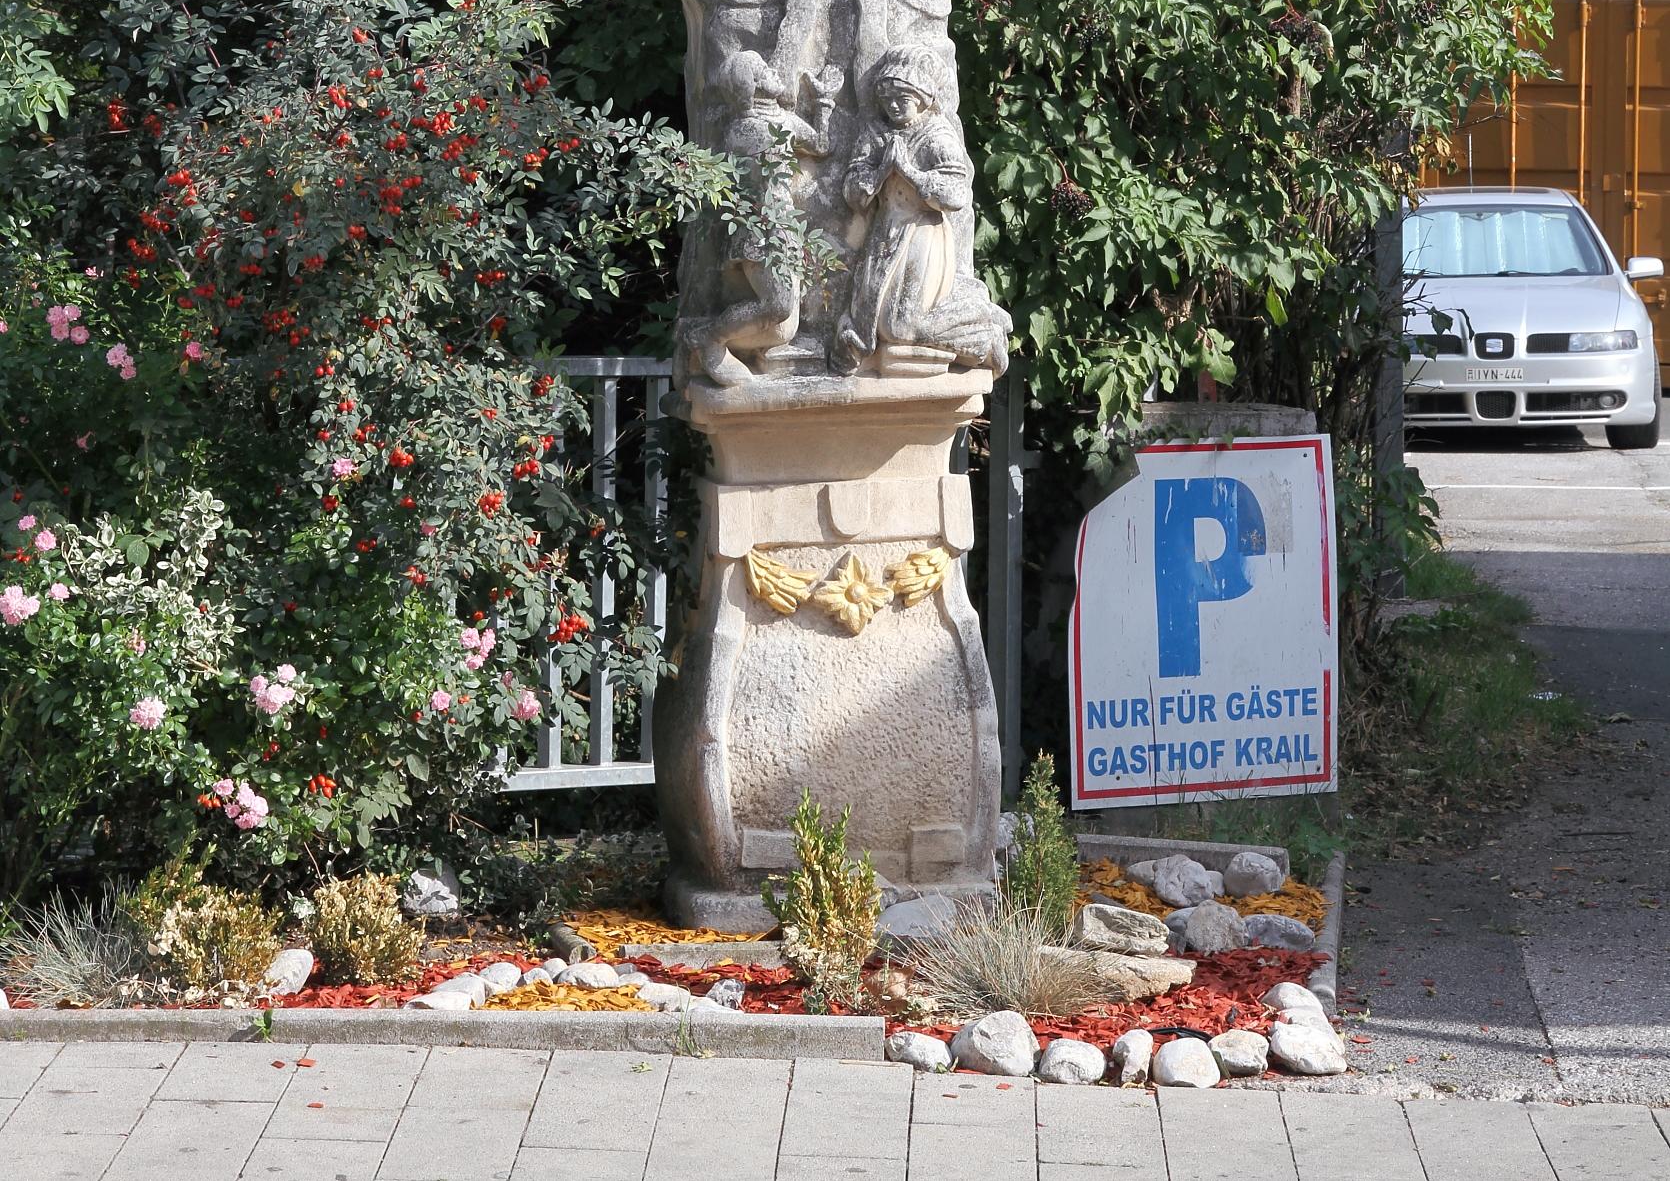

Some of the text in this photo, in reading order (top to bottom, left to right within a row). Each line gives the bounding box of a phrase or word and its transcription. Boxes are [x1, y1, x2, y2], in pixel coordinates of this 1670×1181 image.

[1154, 477, 1267, 678] P
[1087, 685, 1318, 730] NUR FÜR GÄSTE
[1088, 734, 1318, 777] GASTHOF KRAIL
